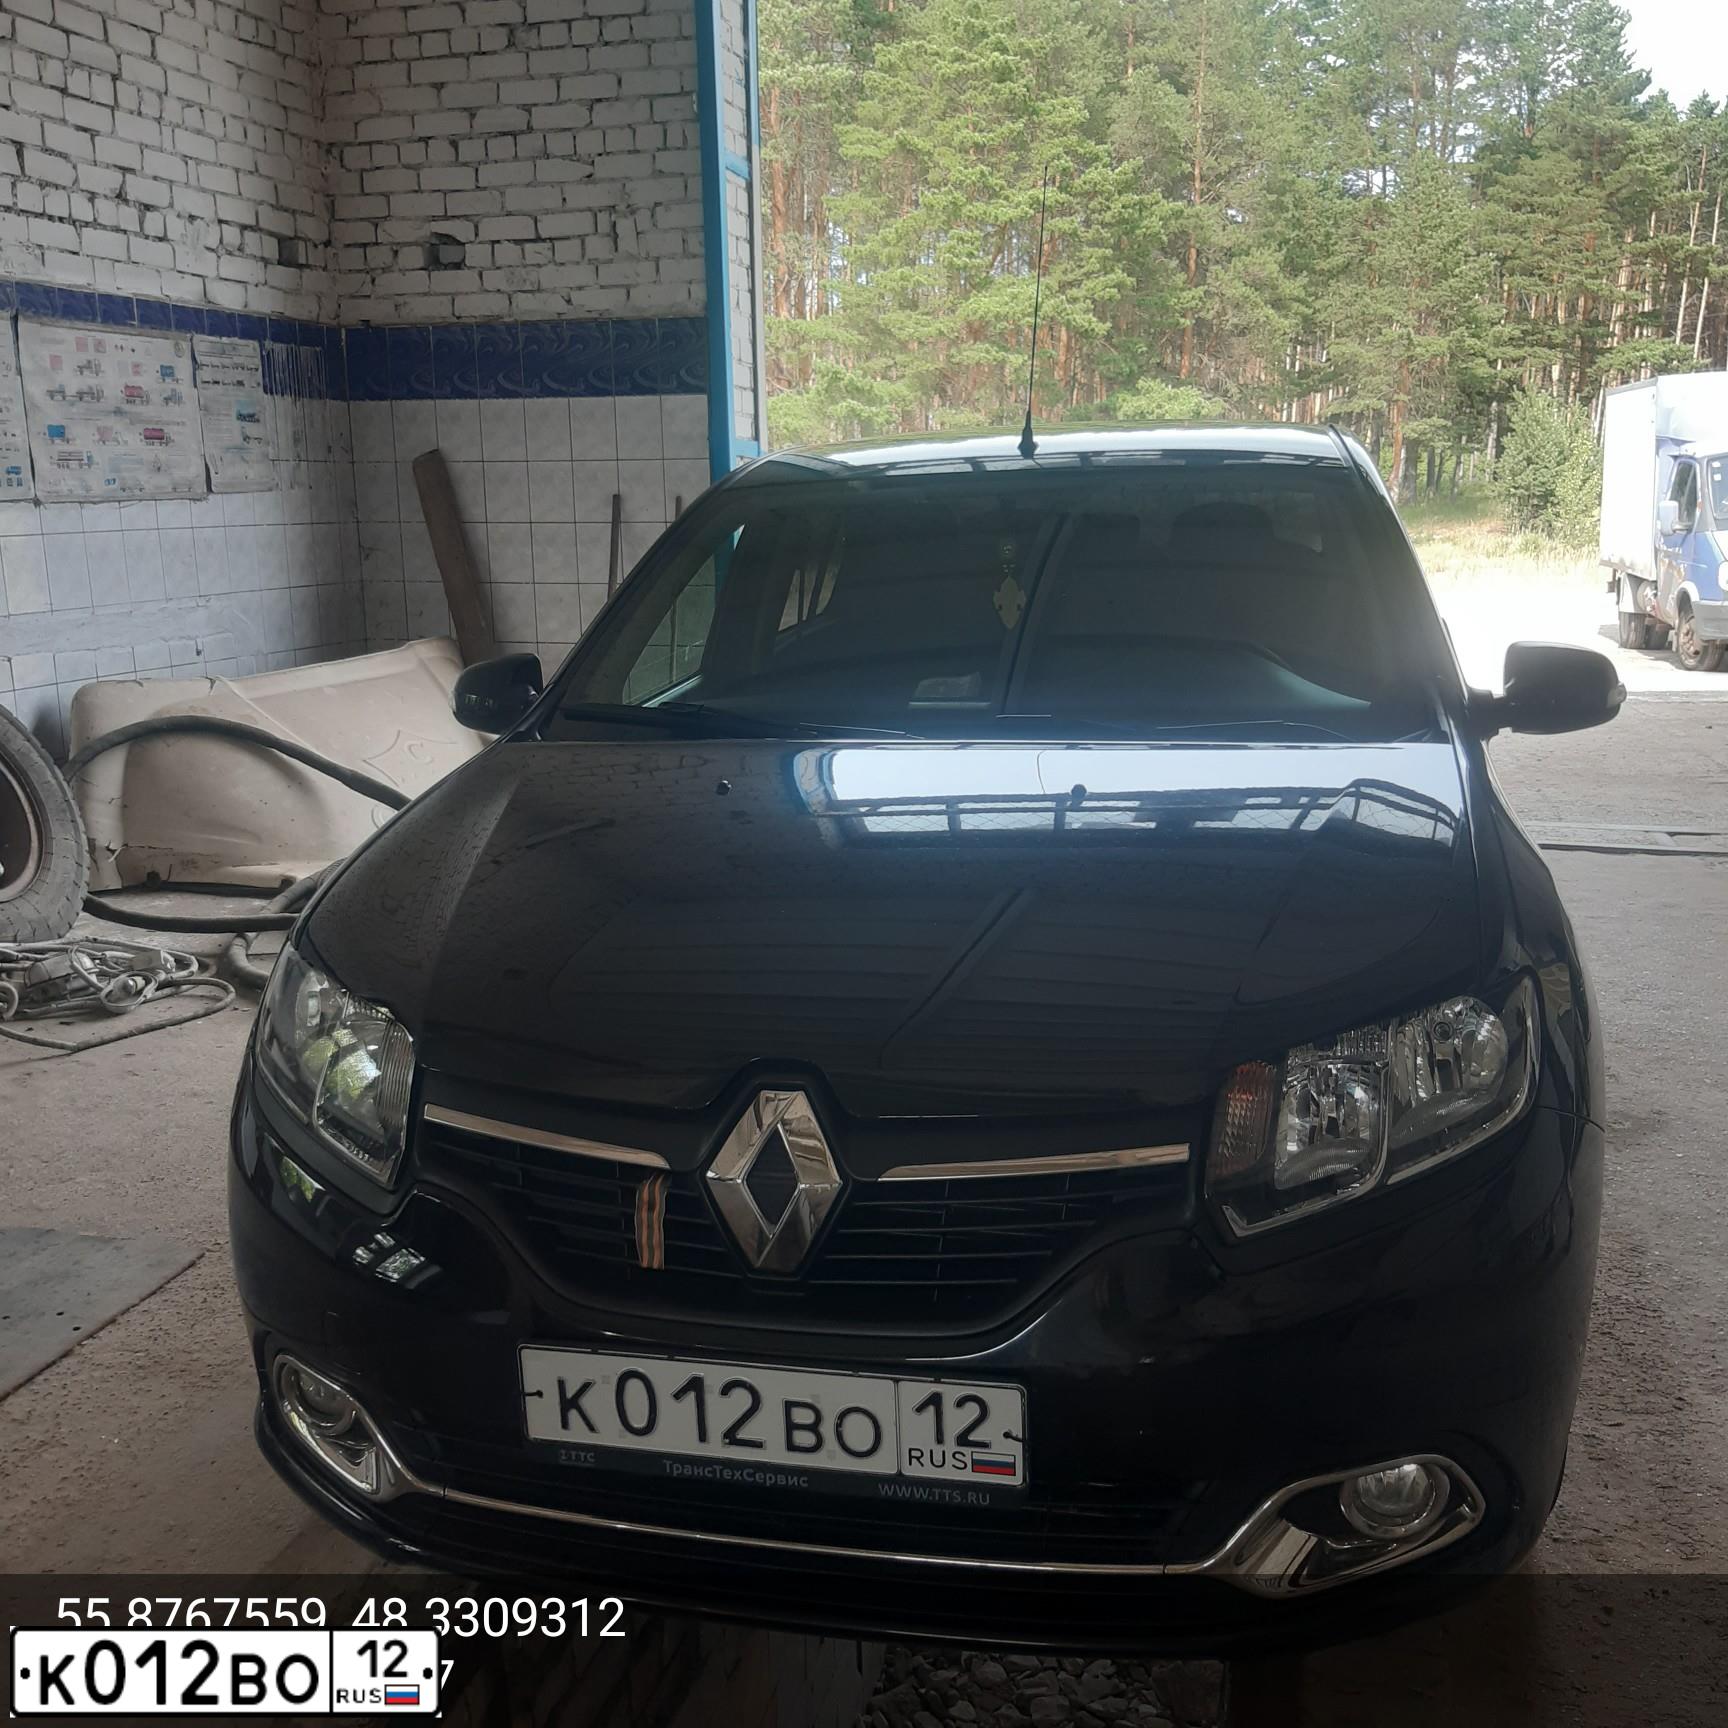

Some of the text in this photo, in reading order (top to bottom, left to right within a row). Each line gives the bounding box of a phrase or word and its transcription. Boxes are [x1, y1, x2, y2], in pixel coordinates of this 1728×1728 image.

[557, 1368, 992, 1460] К012ВО 12
[907, 1447, 968, 1471] RUS
[663, 1459, 809, 1488] ТрансТехСервис
[878, 1482, 991, 1506] WWW.TTS.RU
